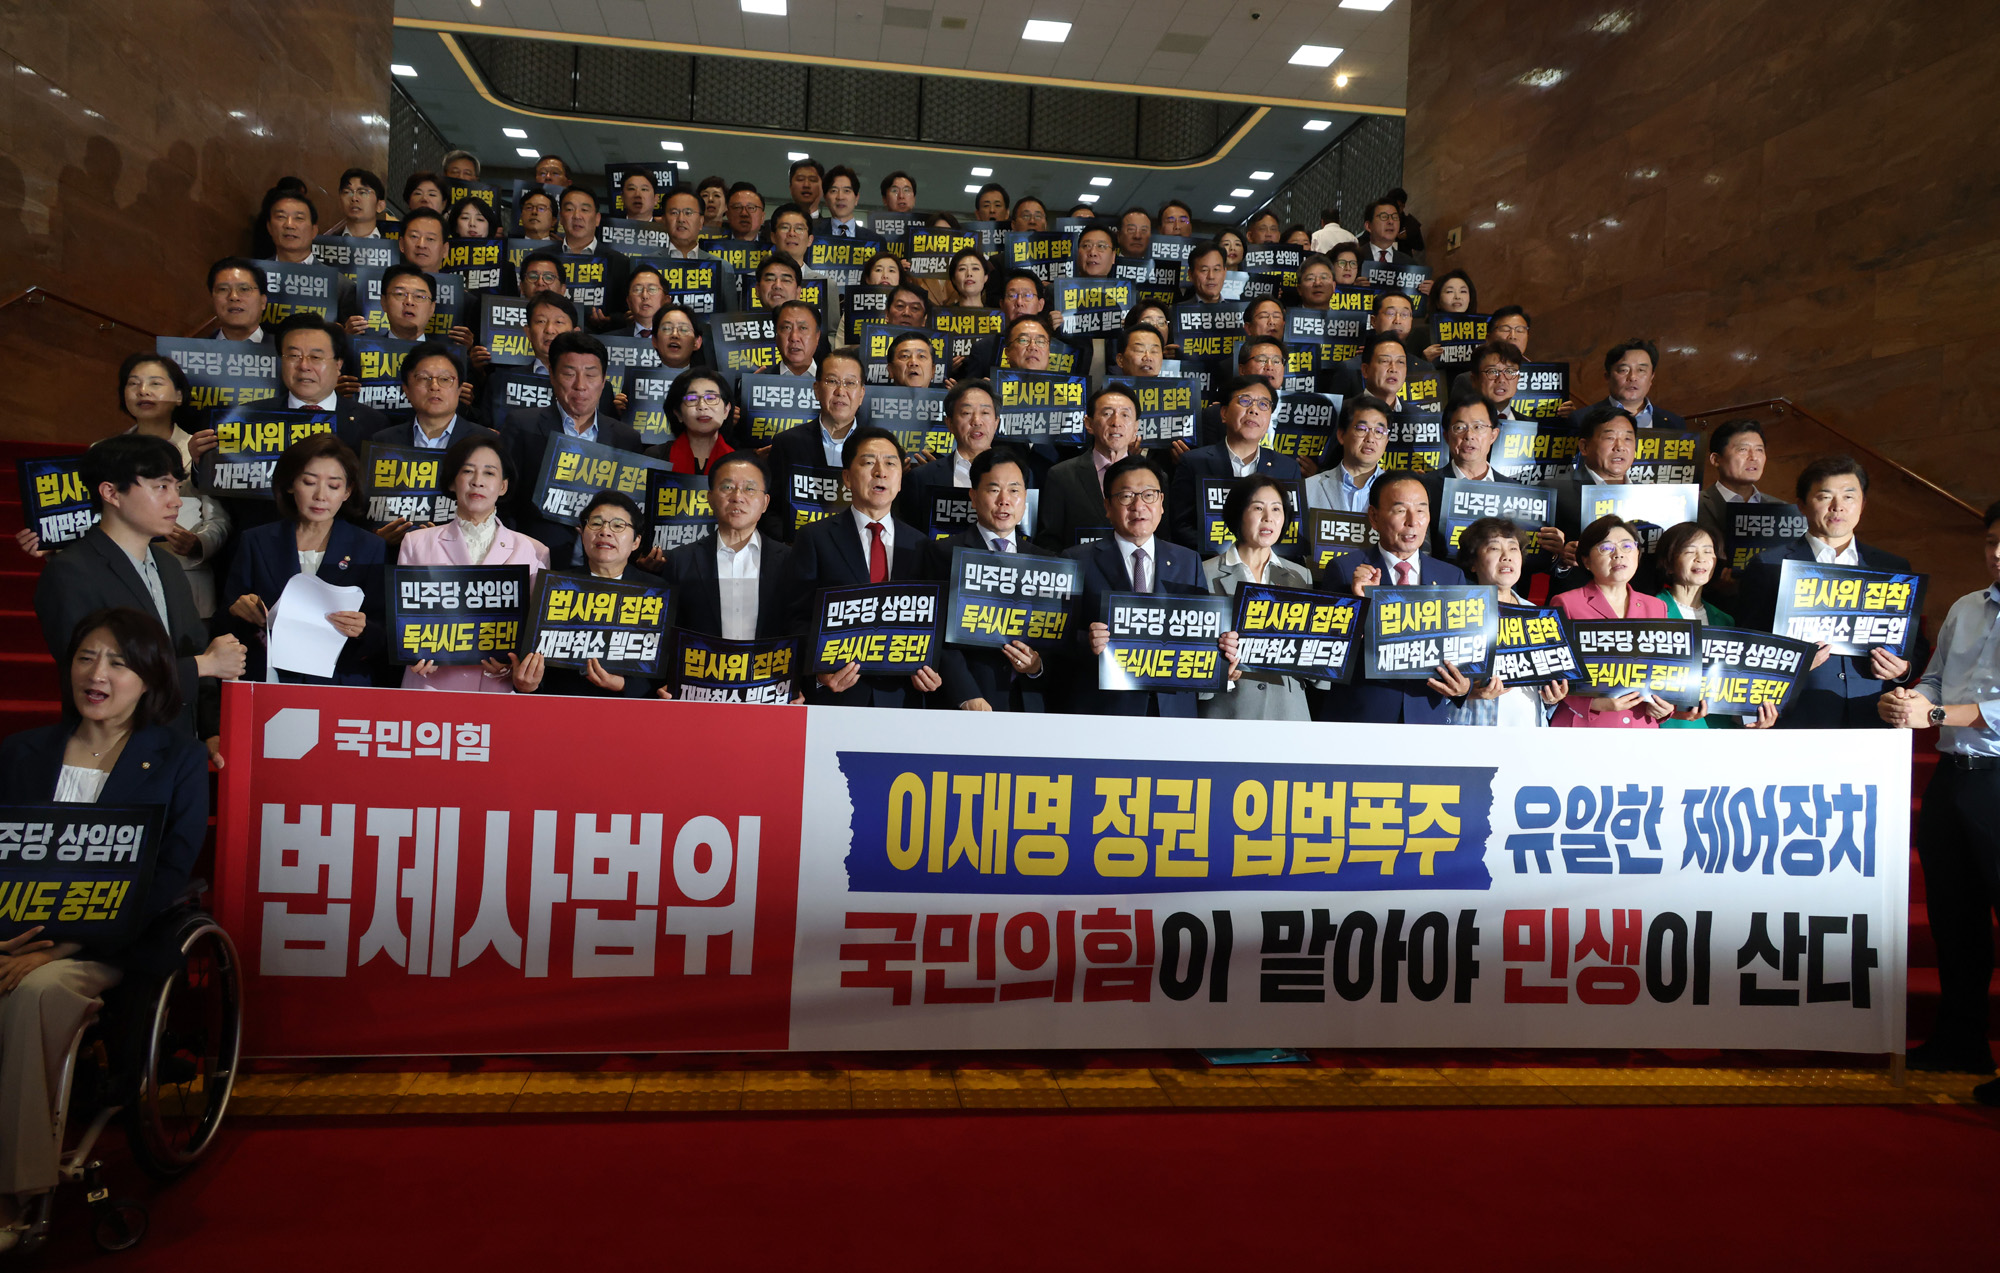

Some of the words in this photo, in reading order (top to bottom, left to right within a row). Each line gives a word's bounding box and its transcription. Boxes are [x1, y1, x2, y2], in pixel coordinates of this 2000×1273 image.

[602, 226, 635, 245] 민주당
[637, 230, 670, 249] 상임위
[875, 219, 905, 235] 민주당
[312, 244, 351, 265] 민주당
[354, 247, 391, 267] 상임위
[812, 244, 850, 265] 법사위
[913, 235, 950, 253] 법사위
[1013, 241, 1049, 261] 법사위
[1051, 239, 1072, 259] 집착
[1152, 242, 1180, 258] 민주당
[440, 245, 469, 270] 사위
[472, 245, 500, 266] 집착
[910, 257, 948, 274] 재판취소
[1245, 249, 1274, 267] 민주당
[1276, 249, 1299, 267] 상임위
[284, 273, 328, 298] 상임위
[468, 268, 500, 290] 빌드업
[578, 263, 604, 284] 집착
[686, 268, 713, 290] 집착
[1116, 264, 1148, 284] 민주당
[1149, 266, 1176, 286] 상임위
[1369, 268, 1396, 287] 민주당
[574, 286, 605, 307] 빌드업
[683, 293, 714, 314] 빌드업
[853, 293, 887, 311] 민주당
[1064, 288, 1104, 311] 법사위
[1105, 286, 1129, 307] 집착
[722, 321, 760, 342] 민주당
[936, 315, 975, 334] 법사위
[977, 315, 1002, 334] 집착
[1062, 312, 1100, 335] 재판취소
[1181, 311, 1213, 330] 민주당
[1293, 317, 1325, 335] 민주당
[1327, 319, 1359, 338] 상임위
[1439, 321, 1475, 342] 법사위
[1477, 322, 1488, 341] 집
[606, 346, 638, 367] 주당
[728, 346, 773, 371] 독식시도
[1183, 337, 1221, 356] 독식시도
[1333, 344, 1357, 362] 중단!
[171, 350, 223, 377] 민주당
[226, 352, 277, 378] 상임위
[360, 351, 403, 379] 법사
[1288, 351, 1314, 373] 집착
[1410, 379, 1438, 401] 집착
[1530, 371, 1563, 391] 상임위
[506, 381, 554, 409] 민주당
[752, 385, 795, 409] 민주당
[1001, 381, 1050, 407] 법사위
[1053, 382, 1084, 406] 집착
[1162, 387, 1192, 411] 집착
[871, 397, 913, 420] 민주당
[916, 399, 947, 422] 상임
[1293, 404, 1334, 427] 상임위
[999, 412, 1047, 436] 재판취소
[1049, 410, 1085, 436] 빌드업
[1159, 414, 1194, 440] 빌드업
[1401, 422, 1440, 443] 상임위
[217, 421, 285, 454] 법사위
[925, 431, 954, 455] 중단!
[1298, 435, 1328, 457] 중단!
[1503, 434, 1551, 459] 법사위
[1552, 436, 1580, 458] 집착
[1663, 439, 1696, 461] 집착
[374, 459, 439, 489] 법사위
[555, 451, 619, 489] 법사위
[1411, 451, 1440, 472] 중단!
[35, 471, 92, 508] 법사
[793, 474, 838, 501] 민주당
[365, 495, 432, 523] 재판취소
[1453, 491, 1501, 515] 민주당
[1502, 498, 1548, 522] 상임위
[1320, 519, 1366, 543] 민주당
[1734, 514, 1775, 538] 민주당
[1777, 516, 1809, 538] 상임
[965, 562, 1018, 596] 민주당
[1021, 569, 1074, 601] 상임위
[400, 581, 460, 610] 민주당
[464, 580, 519, 609] 상임위
[546, 588, 618, 624] 법사위
[619, 596, 664, 626] 집착
[1793, 577, 1863, 609] 법사위
[1863, 582, 1912, 612] 집착
[826, 595, 879, 629] 민주당
[881, 595, 936, 623] 상임위
[960, 603, 1027, 637] 독식시도
[1028, 610, 1069, 641] 중단!
[1113, 606, 1166, 636] 민주당
[1168, 609, 1220, 639] 상임위
[1244, 600, 1311, 632] 법사위
[1311, 605, 1355, 636] 집착
[1379, 599, 1442, 636] 법사위
[1446, 598, 1486, 630] 집착
[402, 622, 475, 654] 독식시도
[477, 620, 519, 651] 중단!
[1496, 617, 1527, 647] 사위
[1526, 616, 1560, 645] 집착
[1579, 630, 1634, 653] 민주당
[1636, 630, 1692, 656] 상임위
[1851, 615, 1908, 646] 빌드업
[536, 628, 607, 660] 재판취소
[607, 630, 660, 661] 빌드업
[820, 634, 888, 666] 독식시도
[888, 633, 931, 663] 중단!
[1236, 637, 1298, 667] 재판취소
[1299, 637, 1350, 669] 빌드업
[1377, 639, 1440, 672] 재판취소
[1442, 633, 1488, 664] 빌드업
[684, 647, 749, 681] 법사위
[752, 648, 793, 682] 집착
[1176, 649, 1218, 680] 중단!
[1493, 653, 1534, 682] 판취소
[1531, 646, 1577, 675] 빌드업
[1745, 642, 1803, 674] 상임위
[1649, 663, 1690, 692] 중단!
[1749, 678, 1791, 706] 중단!
[333, 718, 491, 763] 국민의힘
[885, 770, 1073, 877] 이재명
[1092, 776, 1212, 878] 정권
[1230, 778, 1461, 878] 입법폭주
[1503, 783, 1664, 875] 유일한
[1679, 783, 1878, 878] 제어장치
[0, 822, 55, 861] 주당
[56, 823, 145, 862] 상임위
[0, 880, 63, 922] 시도
[57, 880, 132, 922] 중단!
[258, 802, 762, 979] 법제사법위
[838, 907, 1234, 1006] 국민의힘이
[1259, 908, 1480, 1004] 맡아야
[1502, 907, 1713, 1006] 민생이
[1737, 911, 1879, 1010] 산다
